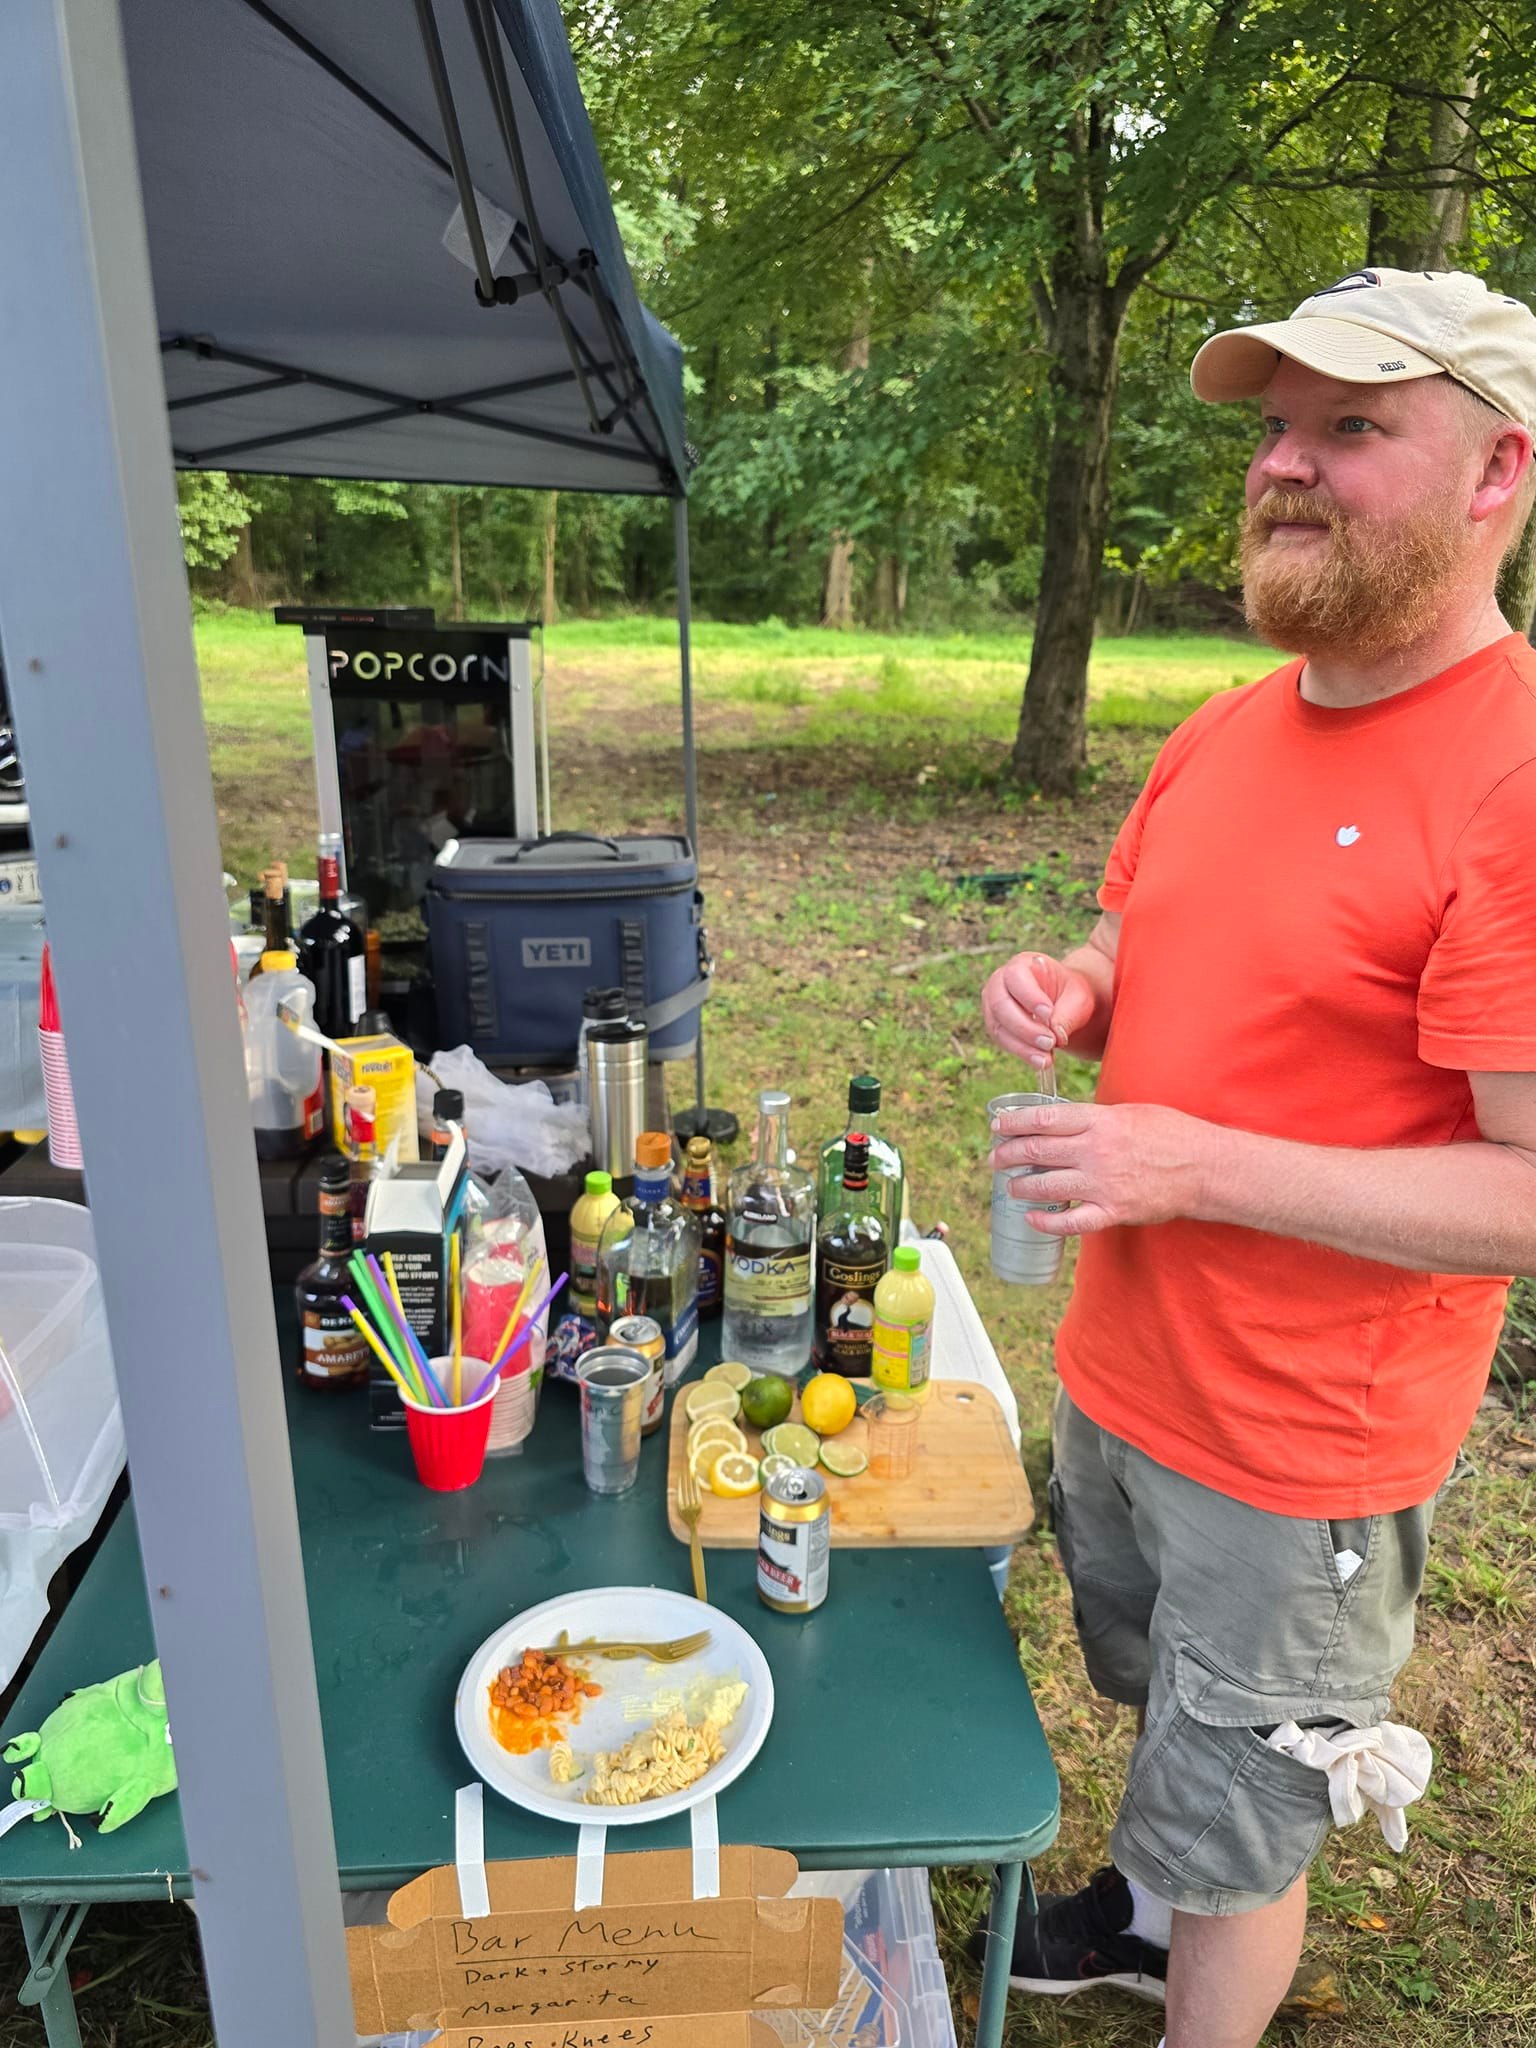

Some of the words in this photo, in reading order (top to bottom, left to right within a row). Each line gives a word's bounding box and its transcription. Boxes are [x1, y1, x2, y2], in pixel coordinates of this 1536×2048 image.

[1377, 360, 1406, 372] REDS
[329, 649, 509, 683] POPCORN
[528, 943, 585, 961] YETI
[729, 1255, 796, 1276] VODKA
[450, 1921, 532, 1954] Bar
[558, 1920, 719, 1952] Menu
[465, 1967, 529, 1985] Dark
[461, 1989, 648, 2019] Margarita
